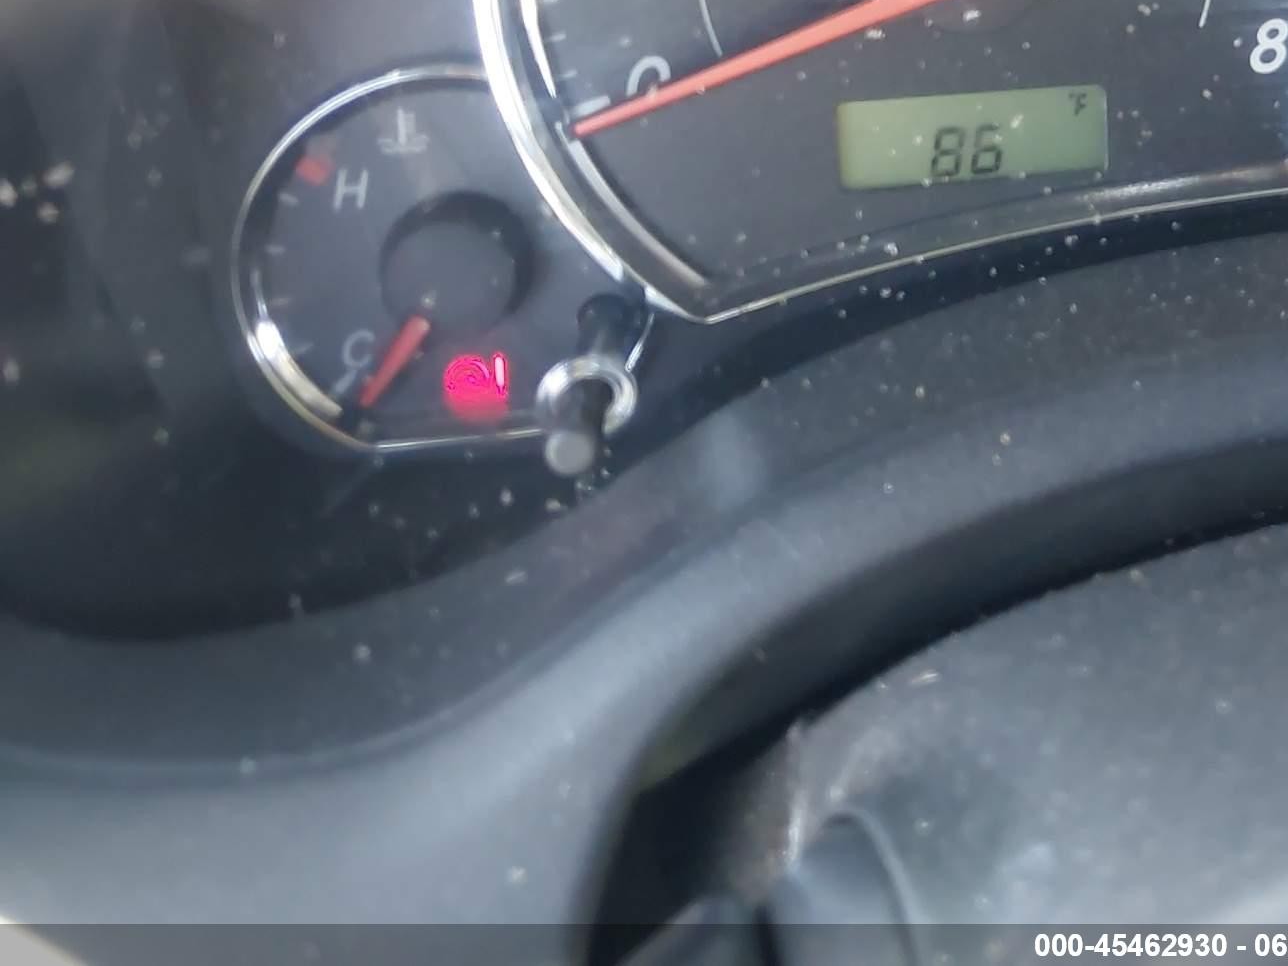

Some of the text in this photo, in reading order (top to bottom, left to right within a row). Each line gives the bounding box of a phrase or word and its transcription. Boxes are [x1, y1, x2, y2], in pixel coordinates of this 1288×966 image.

[930, 126, 1003, 177] 86
[333, 169, 369, 211] H
[343, 330, 374, 368] C
